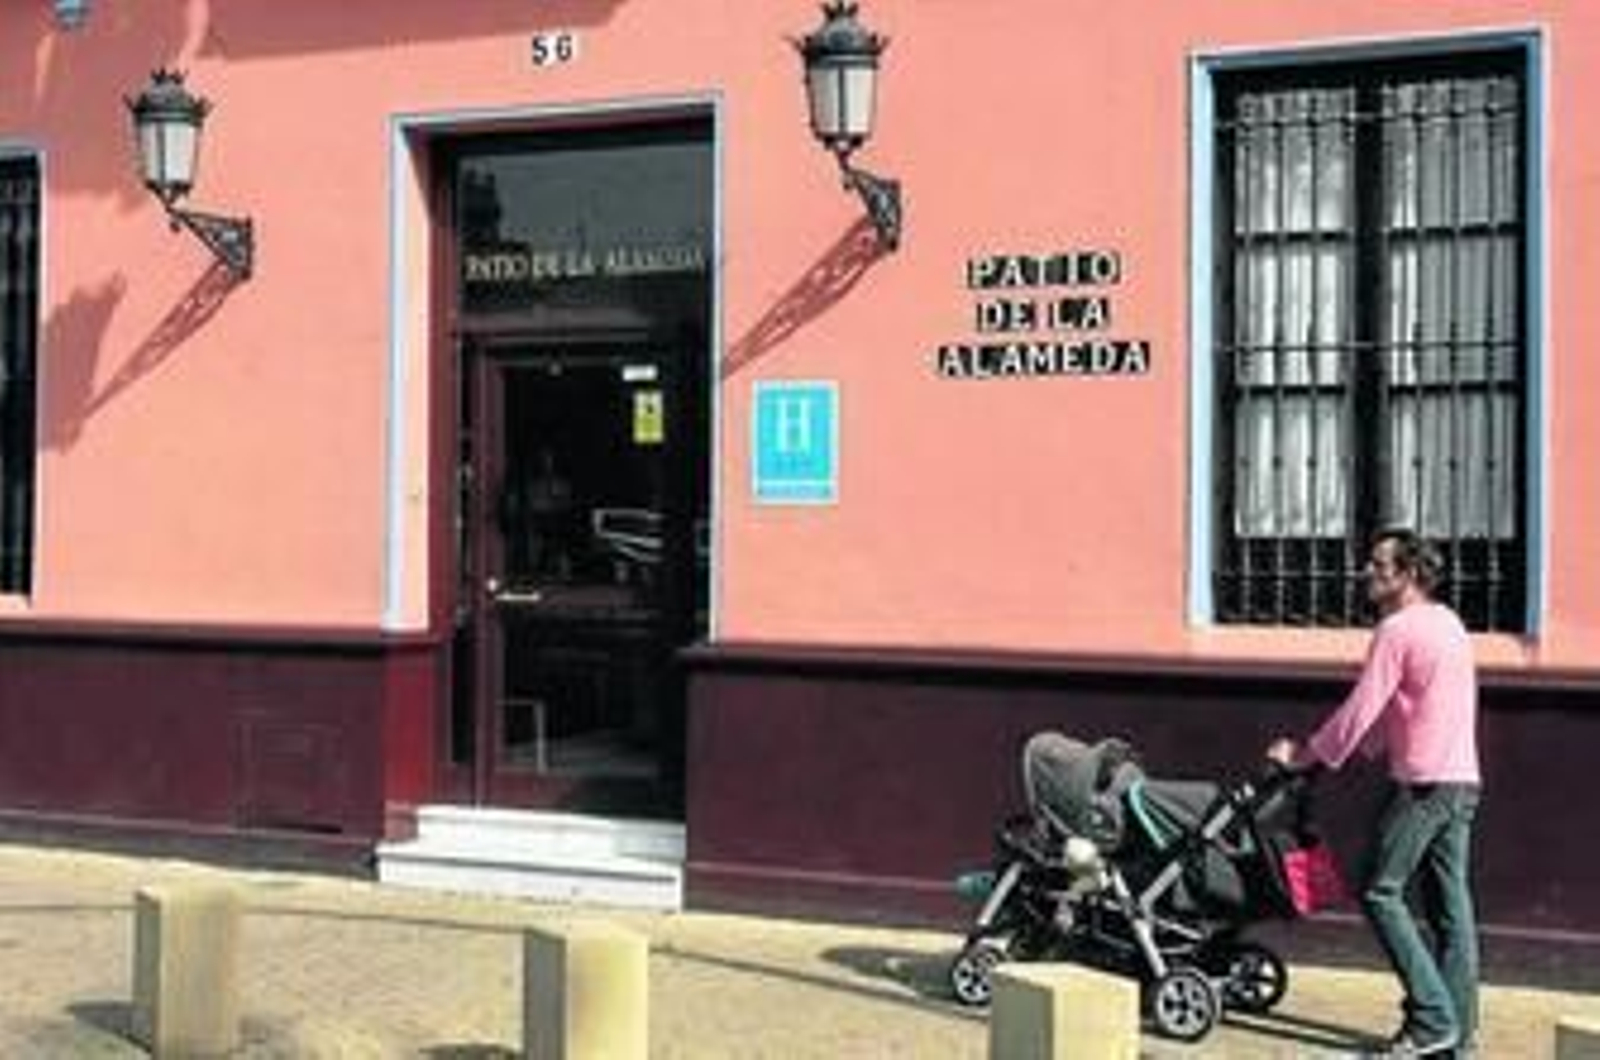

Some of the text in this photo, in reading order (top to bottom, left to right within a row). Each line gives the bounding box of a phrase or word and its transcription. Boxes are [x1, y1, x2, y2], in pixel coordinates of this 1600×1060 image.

[970, 252, 1118, 286] PATIO
[980, 298, 1108, 330] DE LA
[940, 344, 1147, 376] ALAMEDA
[776, 398, 812, 455] H
